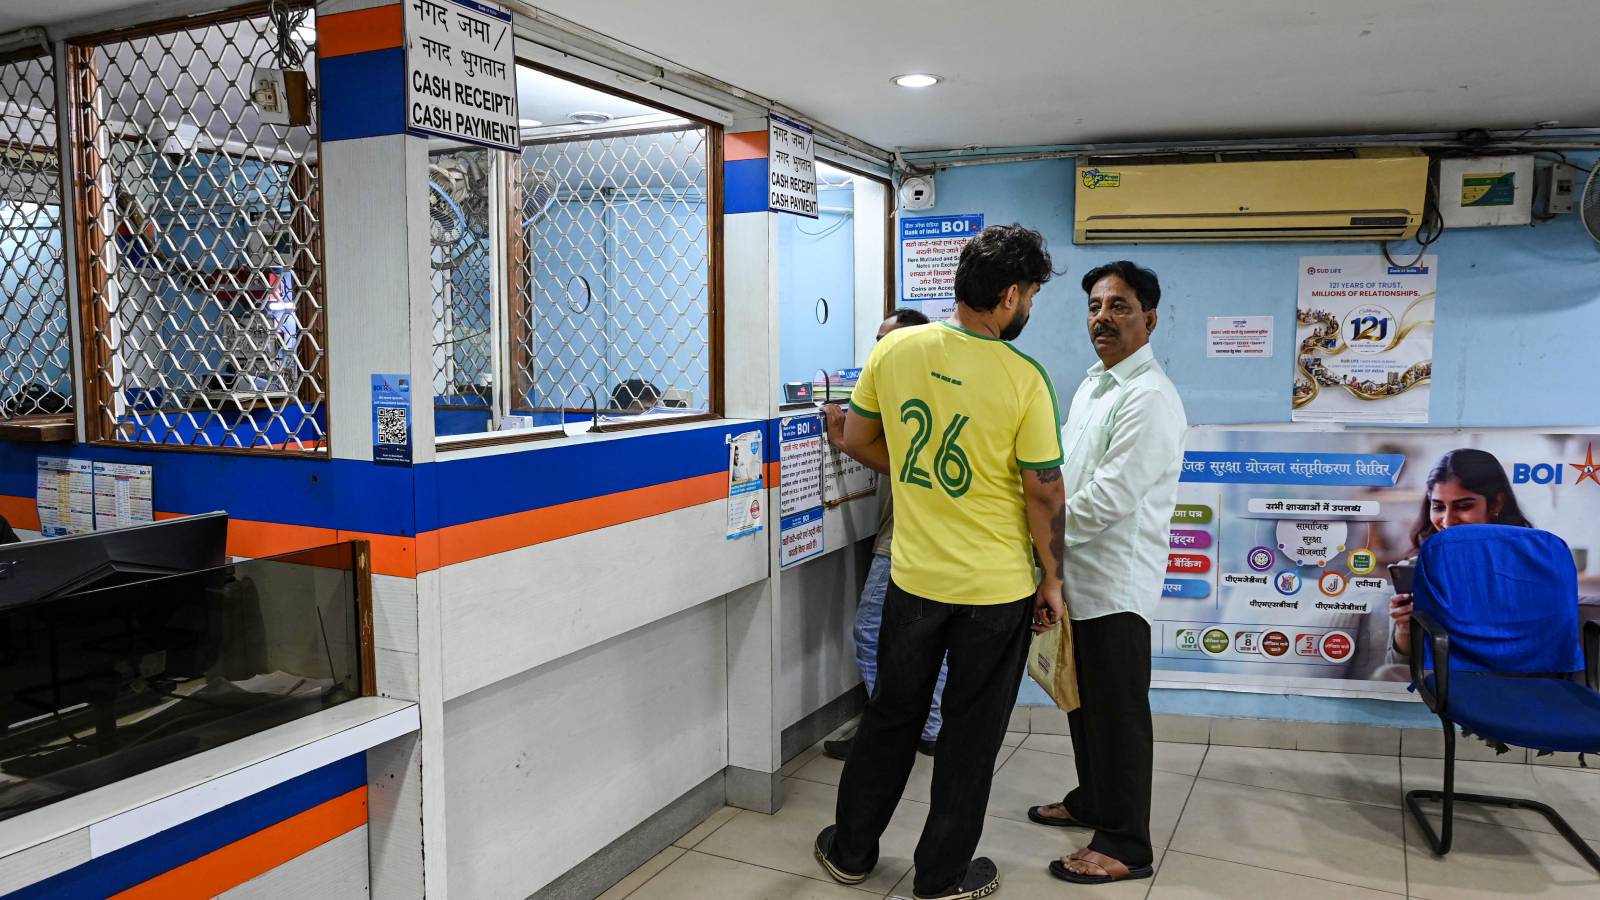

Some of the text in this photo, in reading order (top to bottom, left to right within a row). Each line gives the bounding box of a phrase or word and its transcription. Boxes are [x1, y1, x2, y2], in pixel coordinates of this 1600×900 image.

[413, 0, 506, 51] नगद जमा /
[420, 36, 506, 80] नगद भुगतान
[413, 70, 514, 116] CASH RECEIPT/
[412, 102, 516, 145] CASH PAYMENT
[772, 172, 788, 188] CASH
[772, 192, 816, 213] CASH PAYMENT
[942, 220, 970, 232] BOI
[1350, 316, 1388, 340] 121
[797, 422, 810, 434] BOI
[900, 398, 972, 498] 26
[1210, 460, 1240, 476] सुरक्षा
[1246, 458, 1284, 474] योजना
[1356, 460, 1391, 476] शिविर
[1512, 463, 1563, 484] BOI
[1266, 502, 1284, 512] सभी
[1286, 501, 1320, 512] शाखाओं
[1296, 522, 1328, 532] सामाजिक
[1302, 536, 1322, 545] सुरक्षा
[972, 878, 999, 898] crocs
